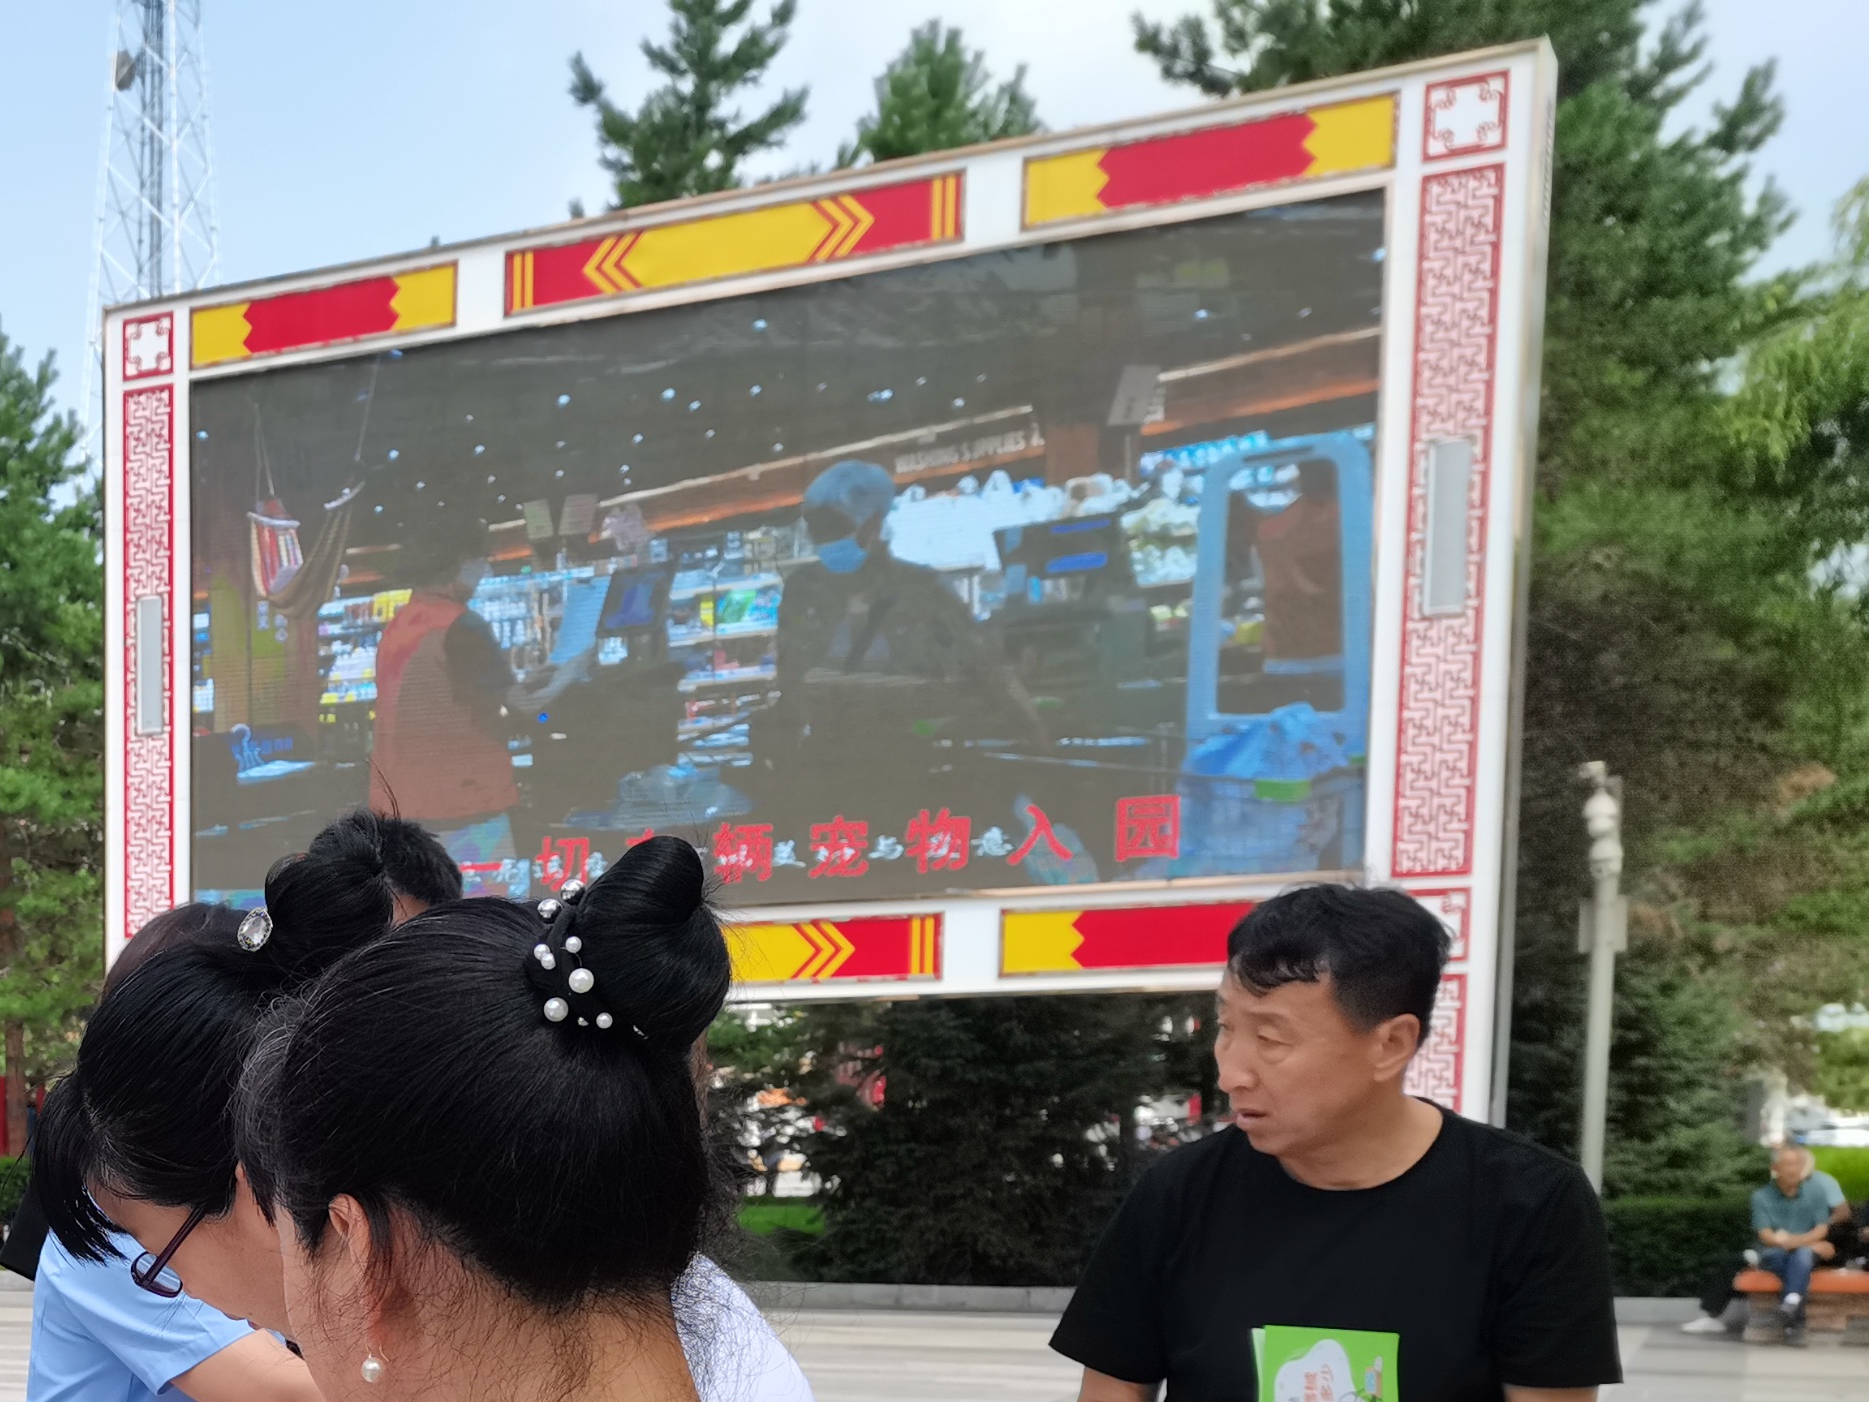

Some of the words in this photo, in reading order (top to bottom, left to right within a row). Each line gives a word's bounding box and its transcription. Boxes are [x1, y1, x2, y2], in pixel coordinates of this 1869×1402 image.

[459, 794, 1180, 892] 一切辆宠物入园
